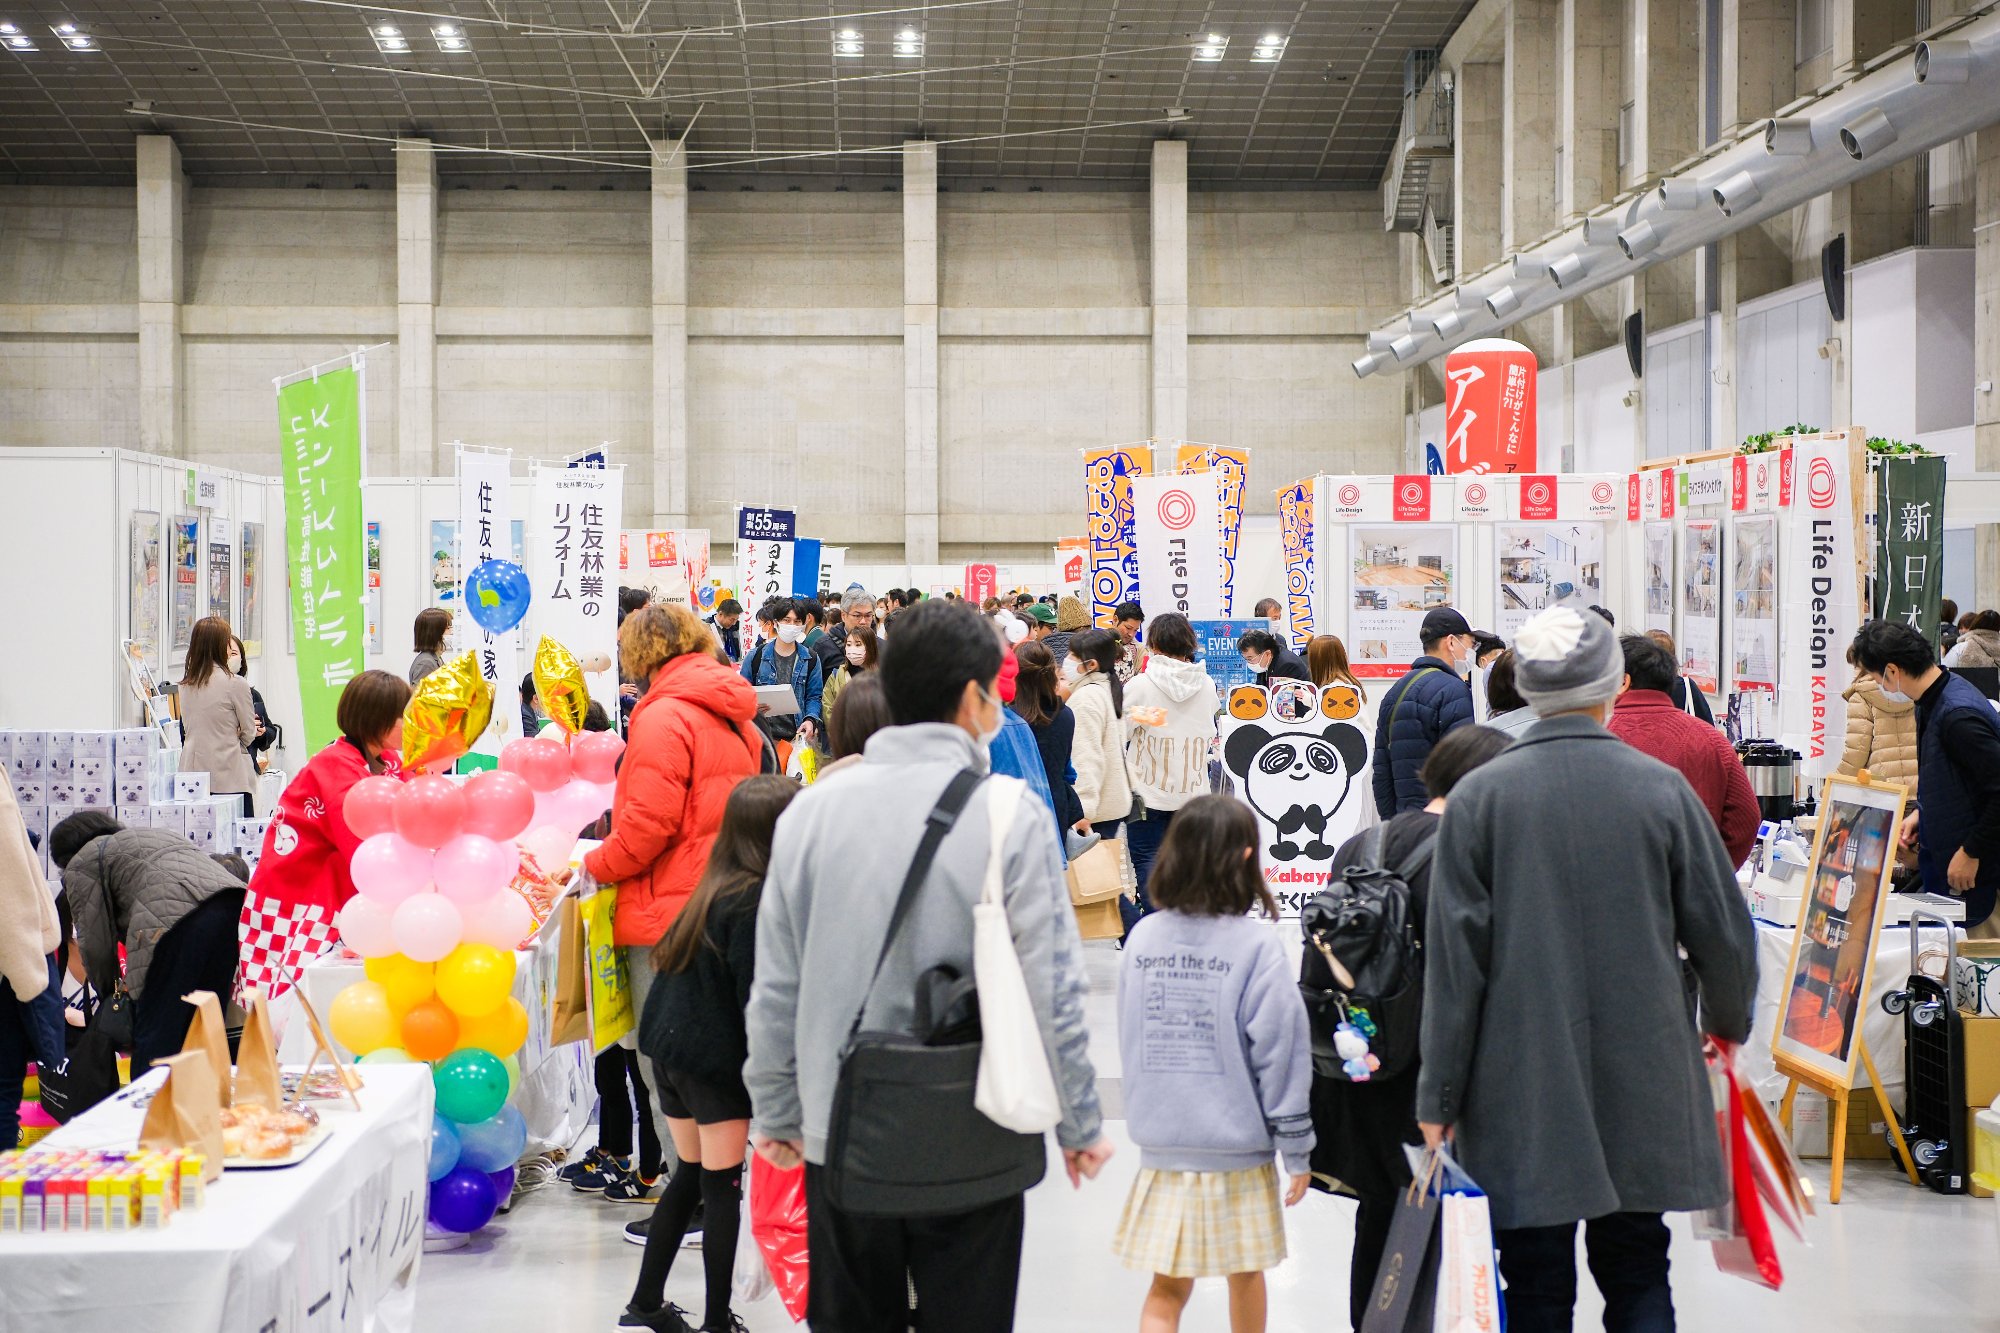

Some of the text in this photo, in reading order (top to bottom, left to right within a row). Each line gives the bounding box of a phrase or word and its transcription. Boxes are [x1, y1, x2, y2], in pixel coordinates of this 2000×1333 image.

[1506, 365, 1528, 455] 片付けがこんなに
[551, 503, 572, 600] リフォーム
[580, 503, 604, 617] 住友林業の
[745, 512, 788, 532] 創業55周年
[765, 543, 782, 594] 日本の
[1809, 519, 1834, 760] Life Design KABAYA
[1135, 953, 1233, 976] Spend the day
